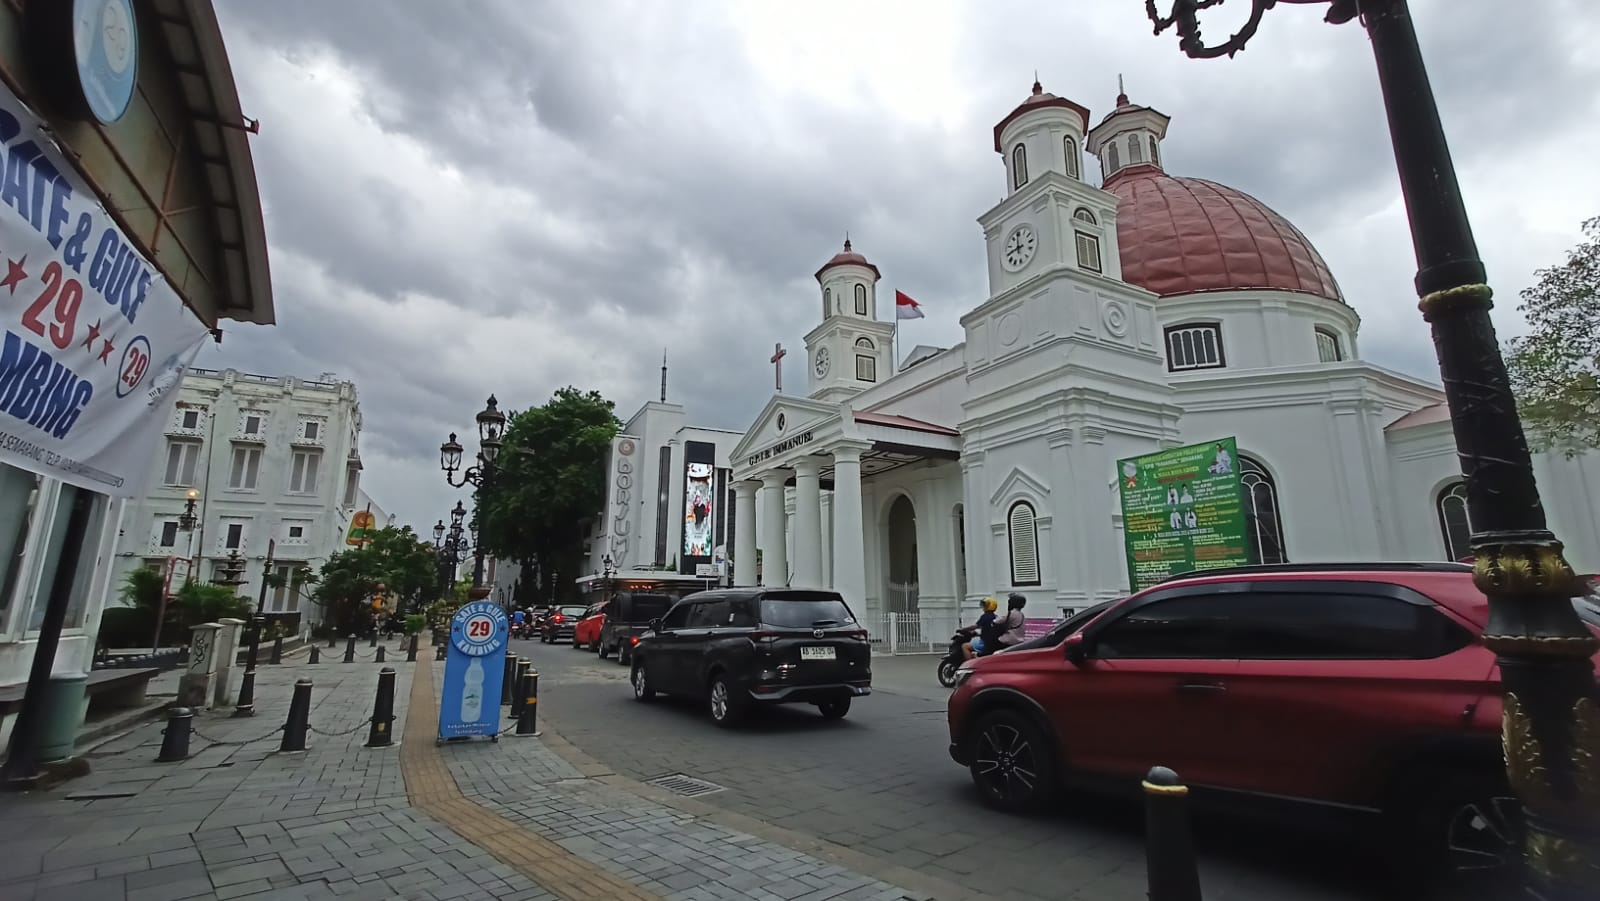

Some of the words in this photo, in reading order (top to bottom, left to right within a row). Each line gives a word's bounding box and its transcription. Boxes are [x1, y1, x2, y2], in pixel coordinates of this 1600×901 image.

[63, 212, 92, 274] &
[88, 228, 152, 324] GULE
[21, 261, 83, 349] 29
[121, 347, 148, 388] 29
[3, 434, 46, 461] SEMARANG
[771, 431, 814, 456] IMMANUEL
[455, 604, 477, 623] SATE
[477, 604, 485, 612] &
[486, 604, 506, 623] GULE
[469, 621, 490, 637] 29
[456, 639, 501, 656] KAMBING
